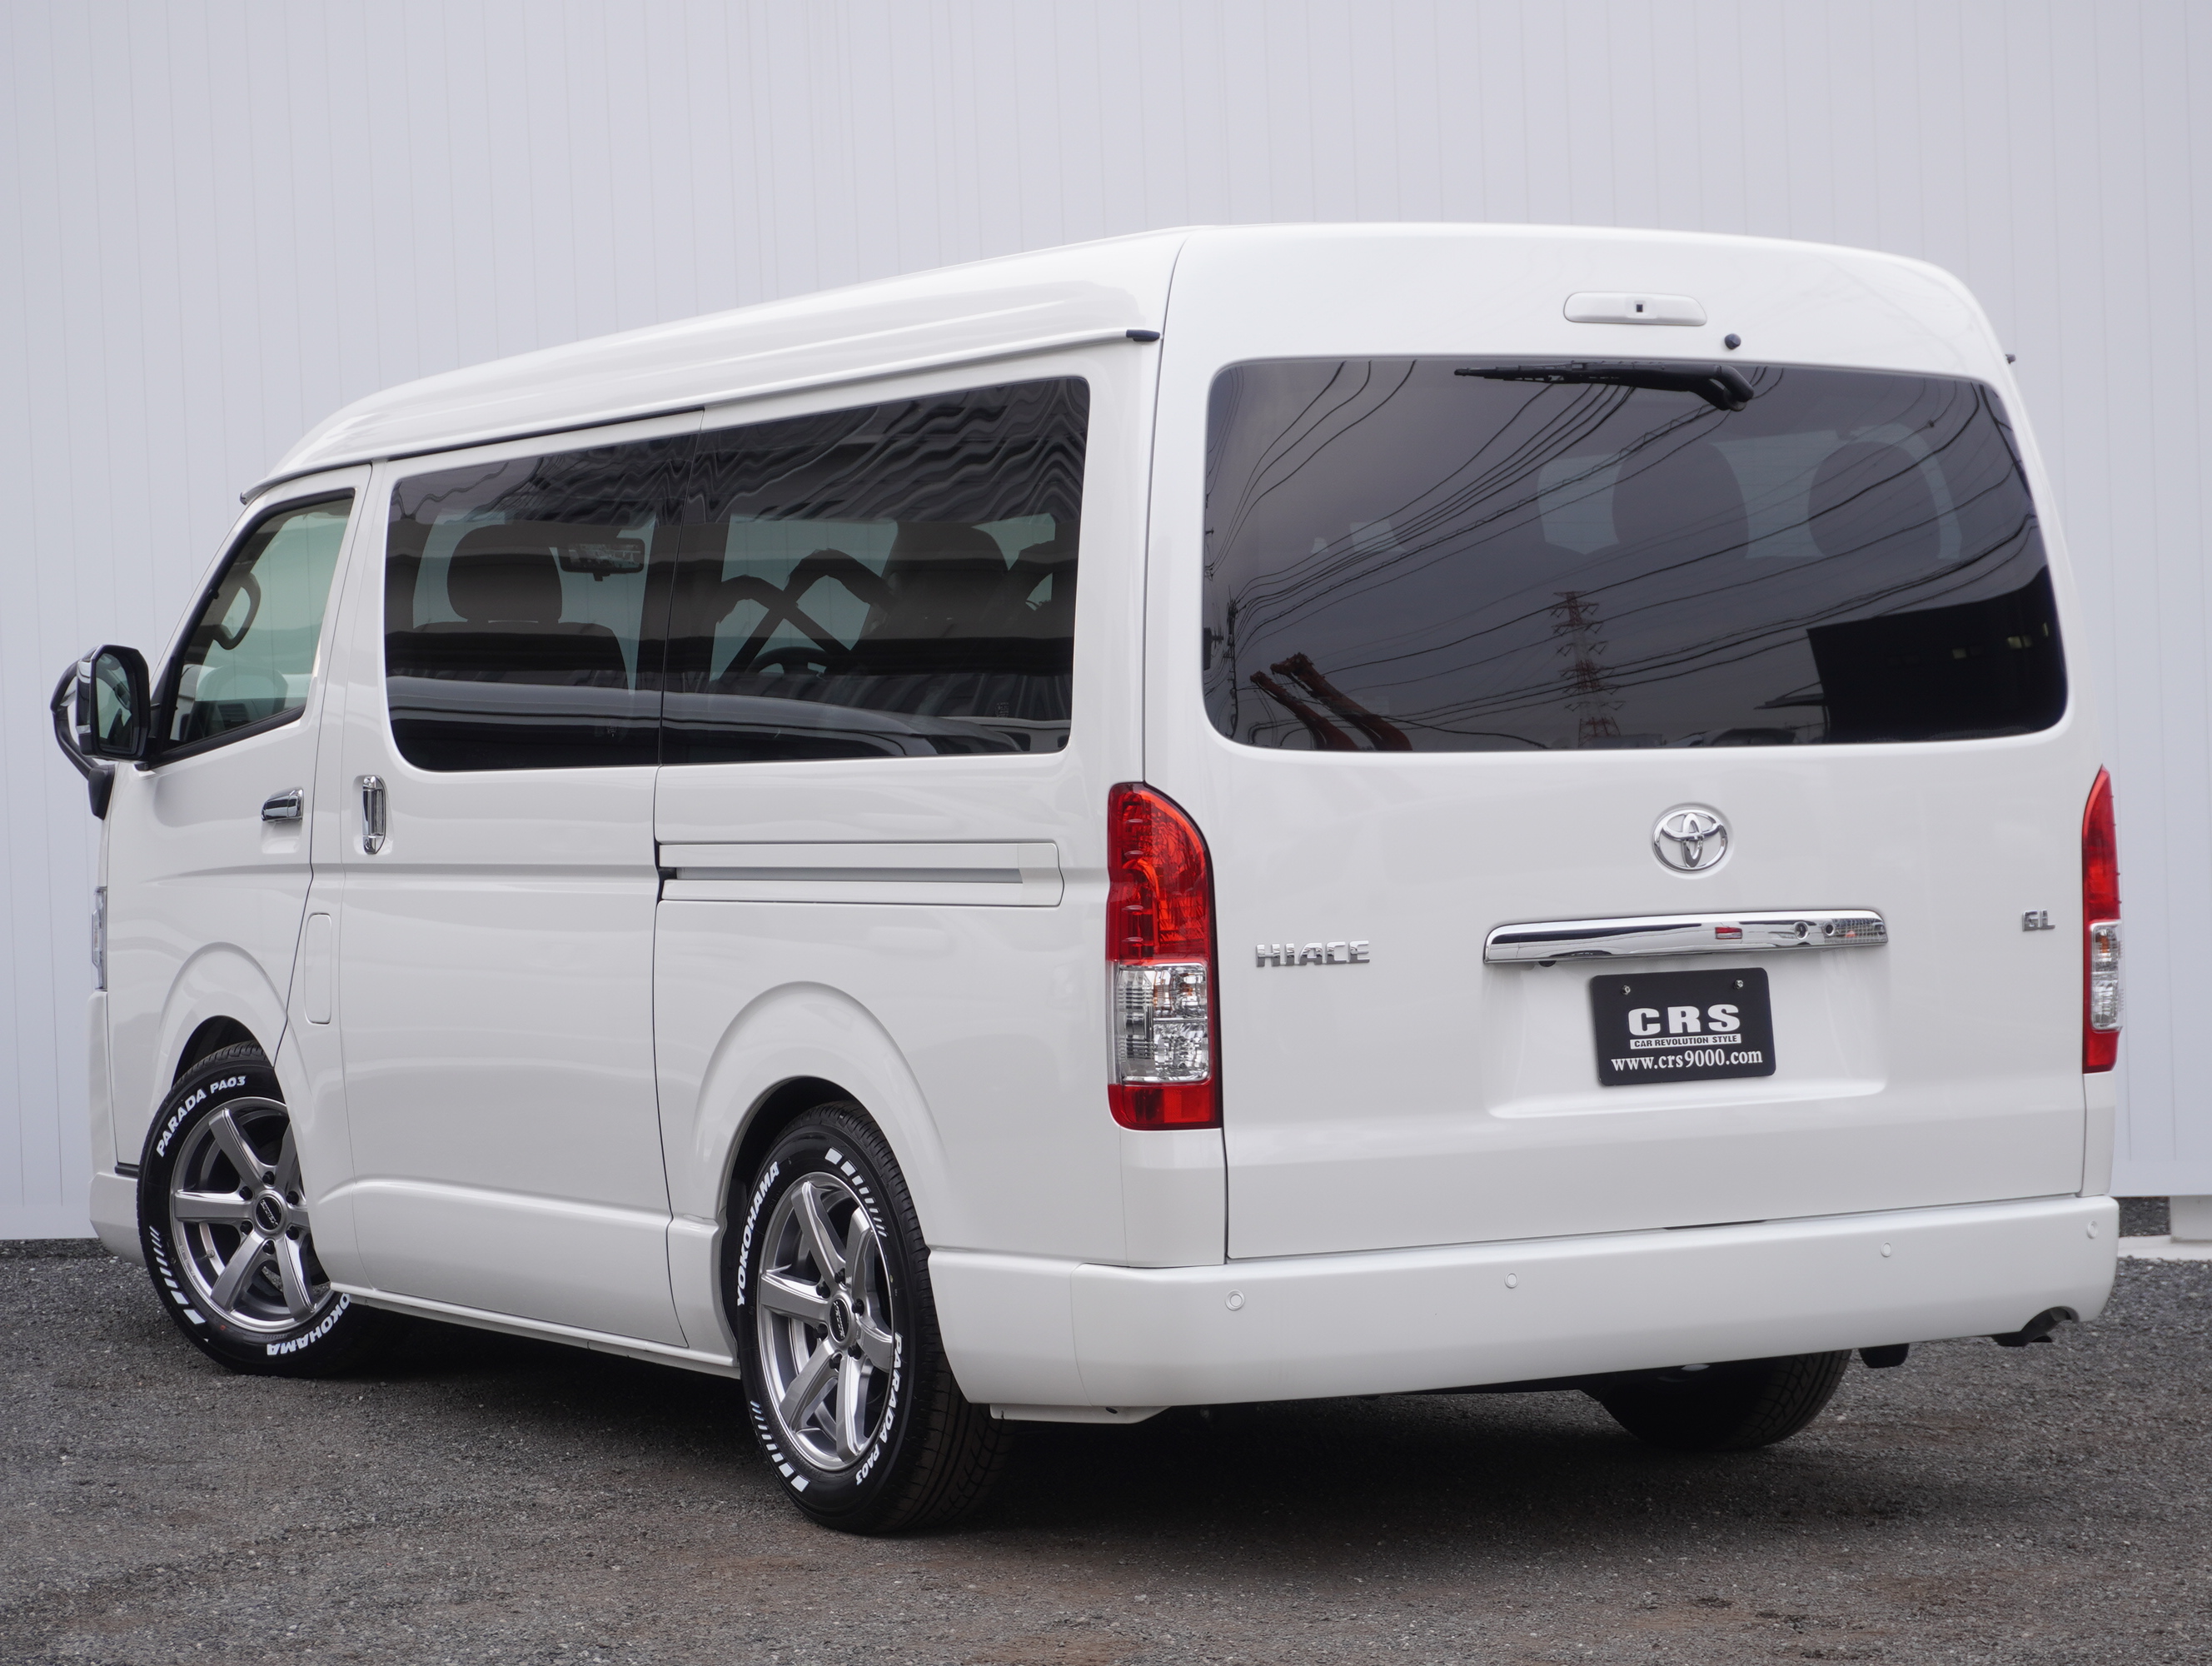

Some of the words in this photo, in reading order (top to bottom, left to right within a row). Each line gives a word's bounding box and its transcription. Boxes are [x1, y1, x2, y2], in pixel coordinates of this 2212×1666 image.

[2022, 910, 2056, 932] GL
[1256, 940, 1371, 968] HIACE
[1628, 1004, 1741, 1036] CRS
[1634, 1040, 1653, 1048] CAR
[1655, 1036, 1709, 1046] REVOLUTION
[1712, 1035, 1737, 1044] STYLE
[1611, 1048, 1764, 1071] www.crs9000.com
[156, 1088, 207, 1158] PARADA
[737, 1160, 780, 1306] YOKOHAMA
[267, 1292, 351, 1356] OKOHAMA
[879, 1332, 903, 1444] PARADA
